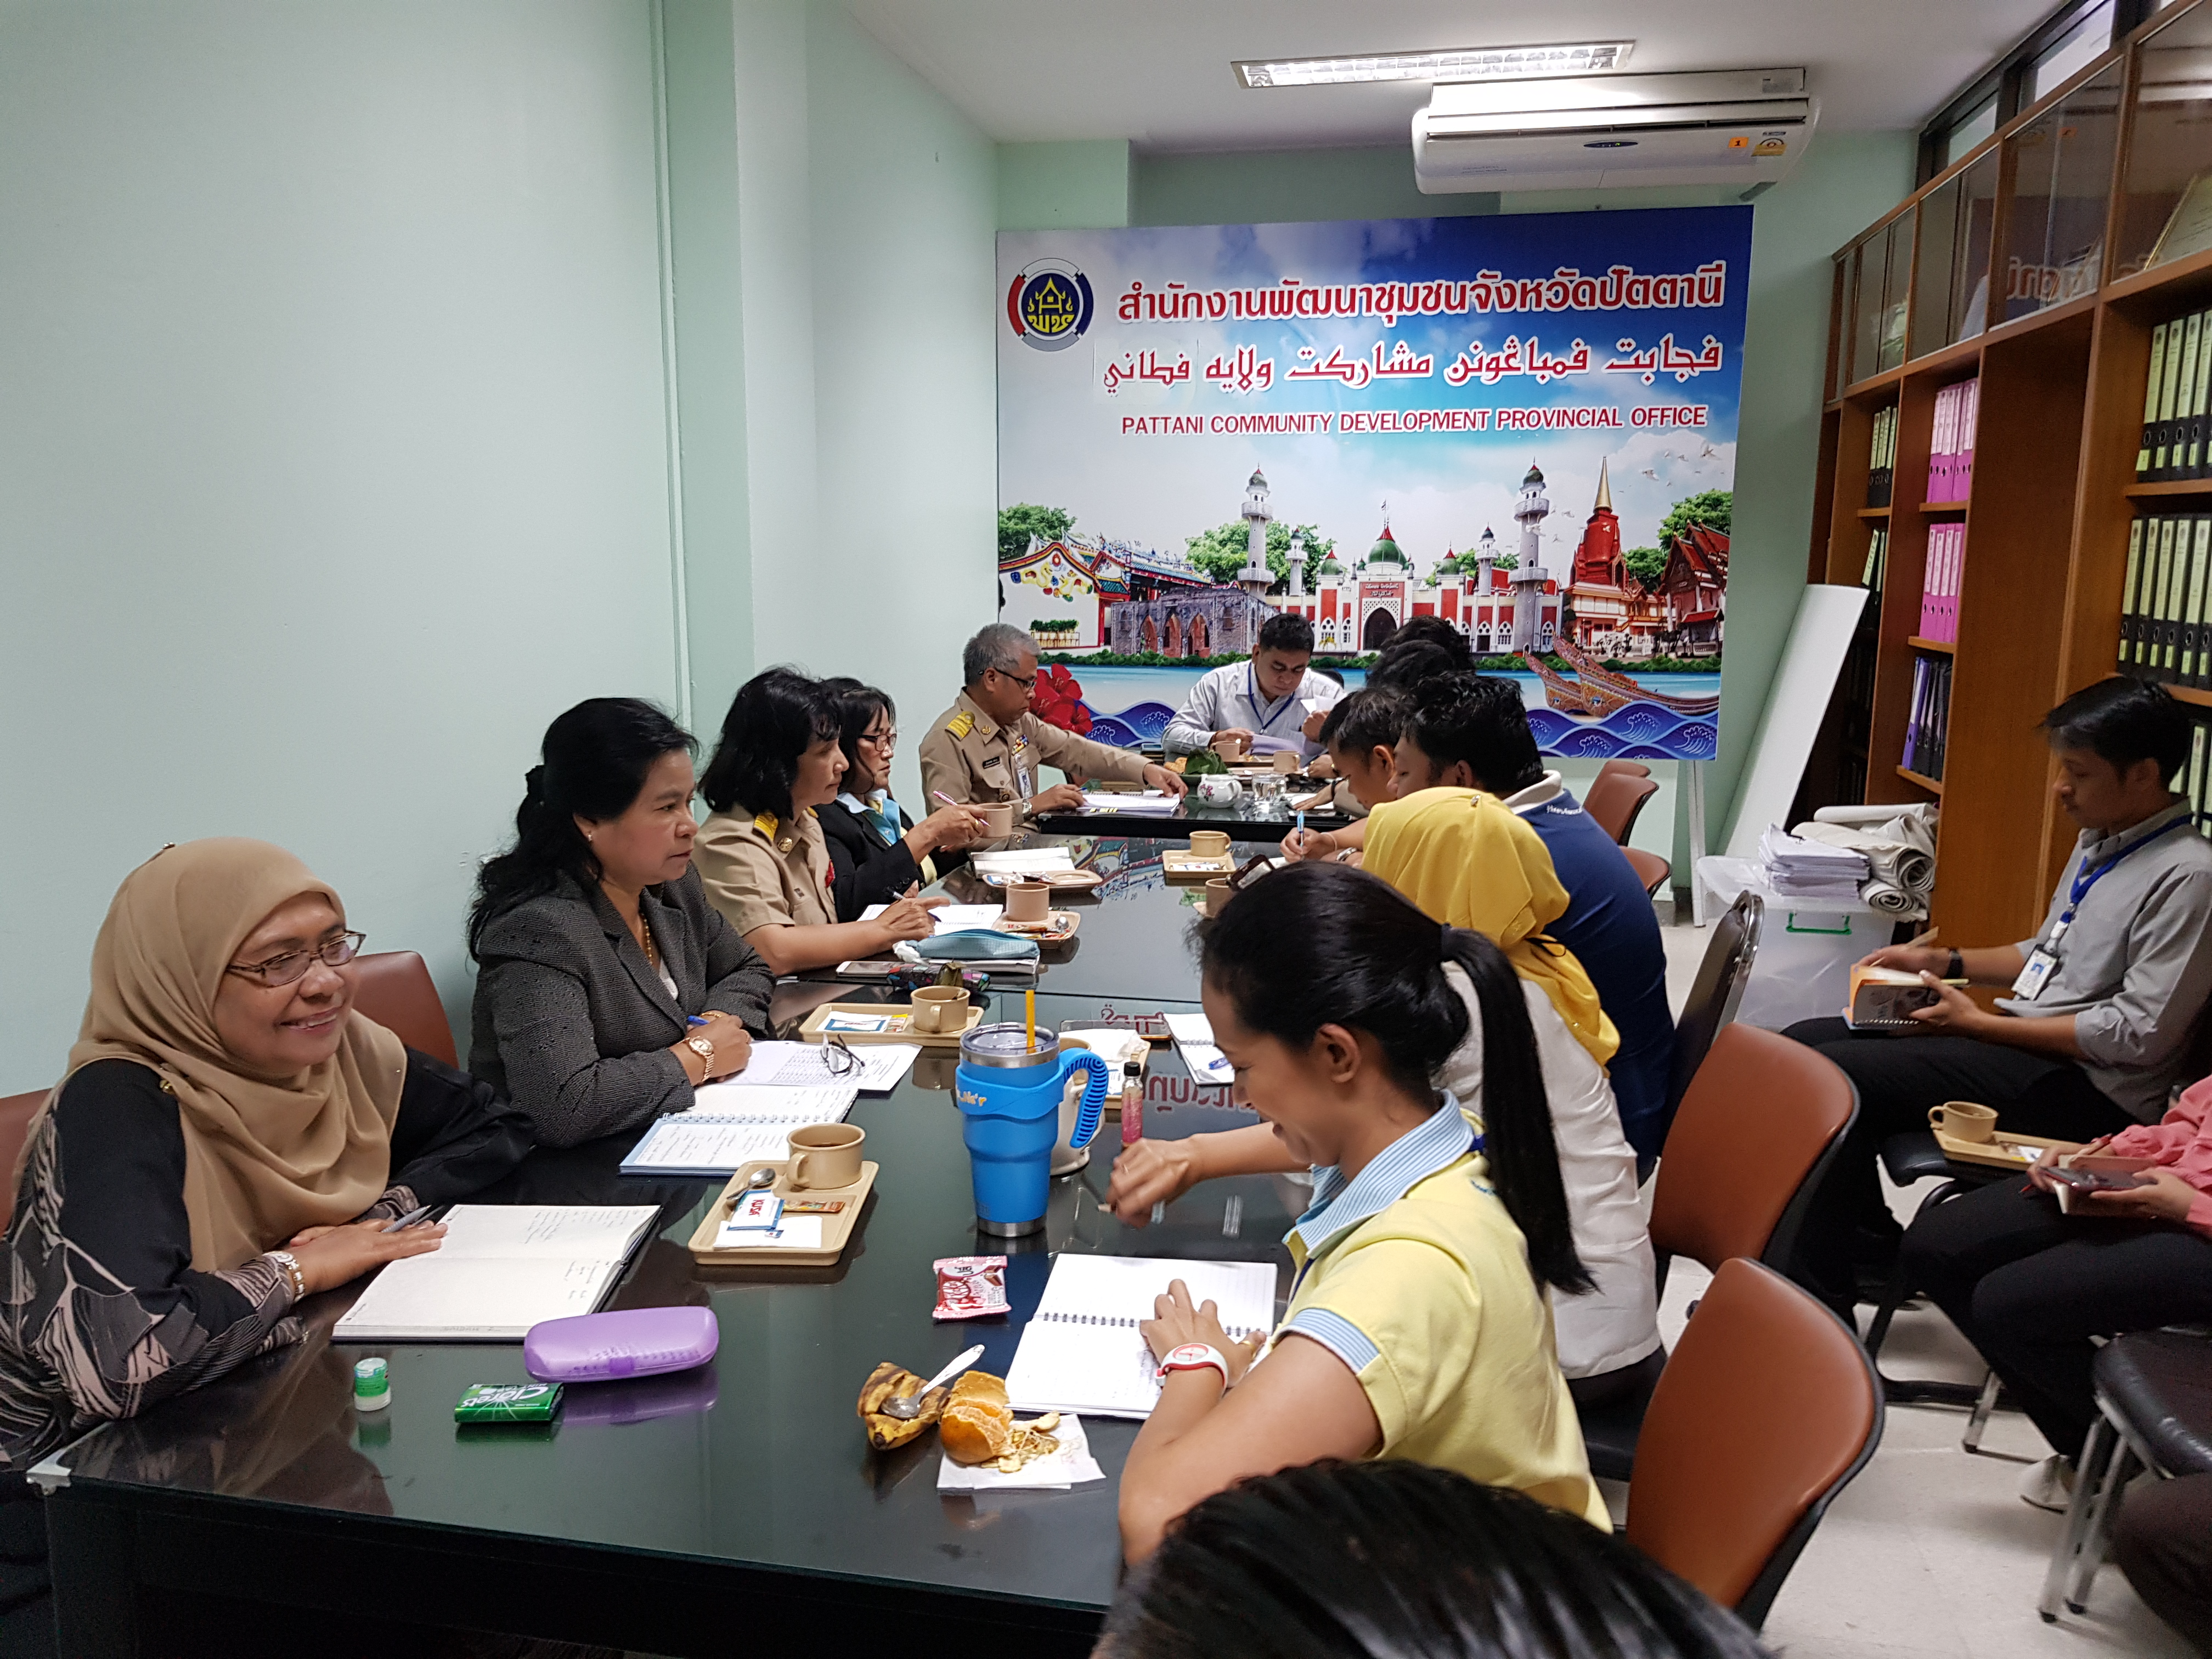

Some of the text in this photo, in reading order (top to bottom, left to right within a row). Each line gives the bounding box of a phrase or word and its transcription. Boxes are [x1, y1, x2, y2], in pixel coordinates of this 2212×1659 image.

[1118, 263, 1723, 324] สำนักงานพัฒนาชุมชนจังหวัดปัตตานี
[1122, 407, 1707, 434] PATTANI COMMUNITY DEVELOPMENT PROVINCIAL OFFICE
[461, 1386, 548, 1407] Clorets
